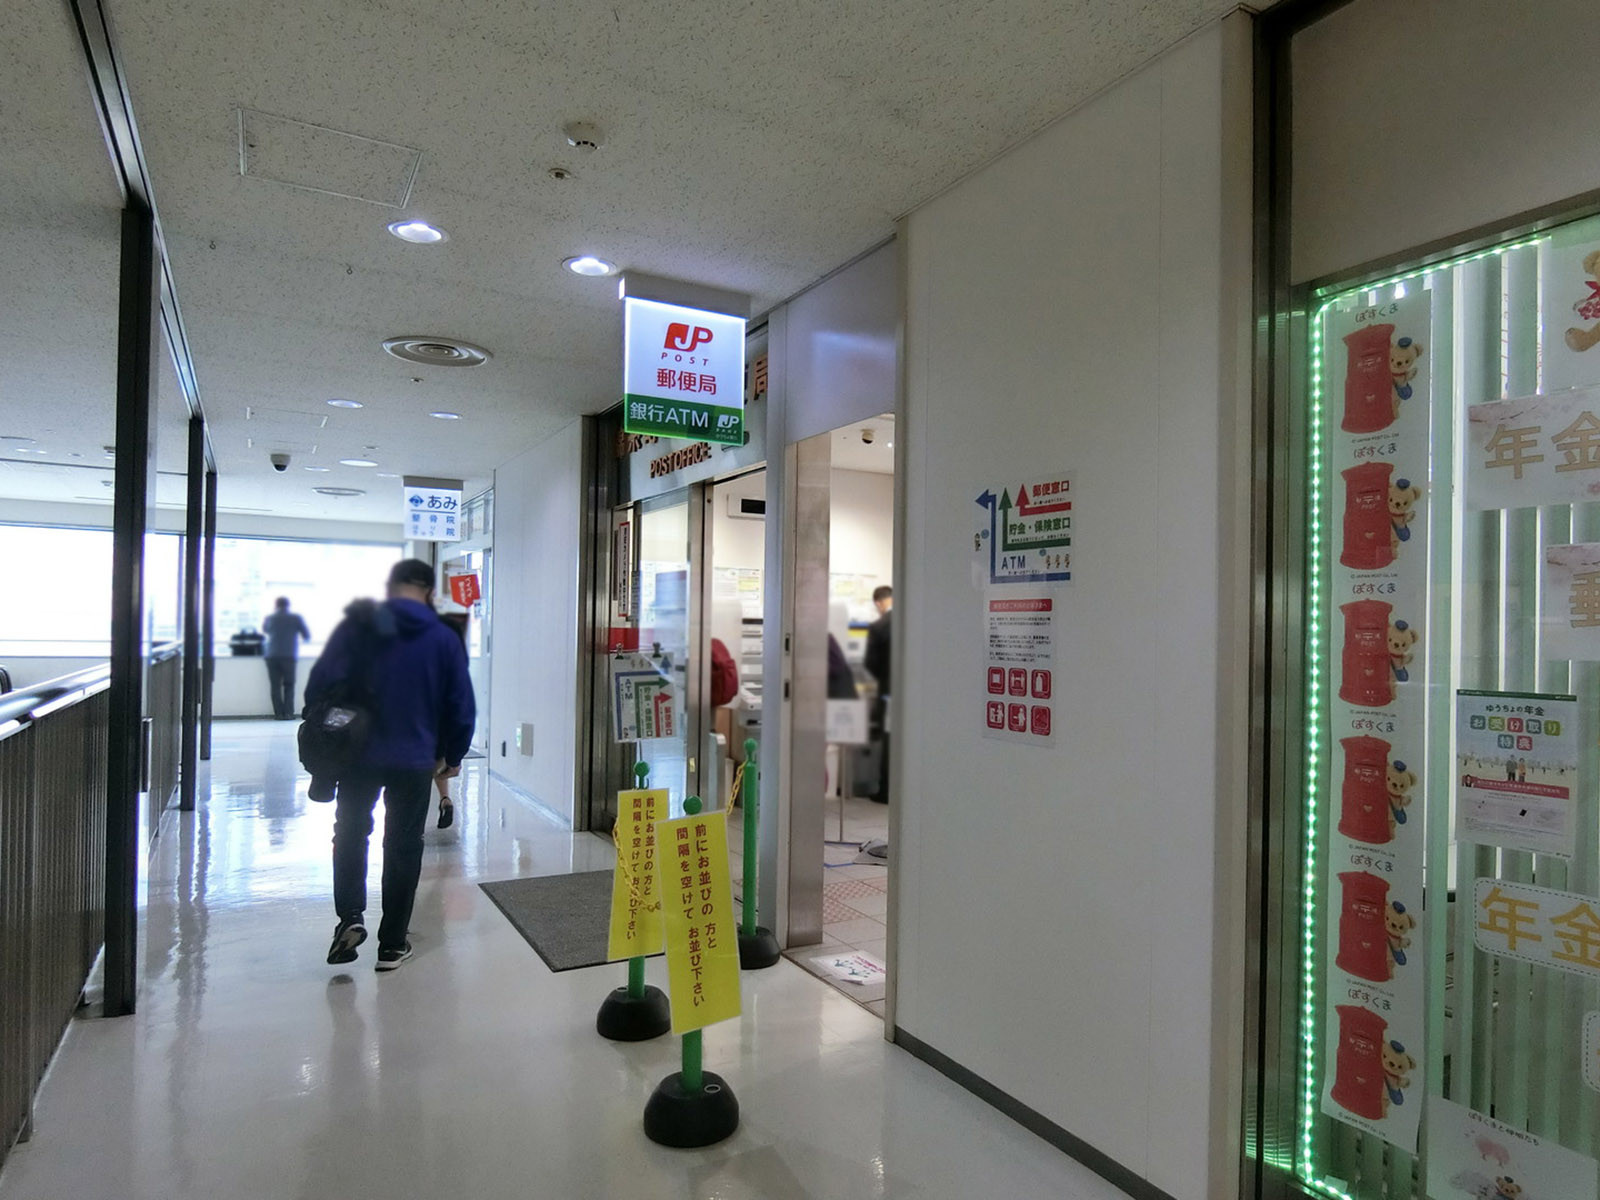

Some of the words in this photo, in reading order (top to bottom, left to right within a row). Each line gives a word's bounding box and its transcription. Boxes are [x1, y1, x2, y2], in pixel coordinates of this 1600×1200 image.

[661, 352, 709, 366] POST
[657, 368, 716, 395] 郵便局
[630, 402, 708, 428] 銀行ATM
[649, 452, 676, 478] POST
[1032, 480, 1070, 498] 郵便窓口
[427, 495, 457, 510] あみ
[1009, 516, 1070, 536] 貯金・保険窓口
[1001, 555, 1026, 570] ATM
[625, 678, 633, 700] ATM
[1485, 705, 1545, 717] ゆうちょの年金
[1471, 717, 1559, 735] お受け取り
[1499, 736, 1531, 750] 特典
